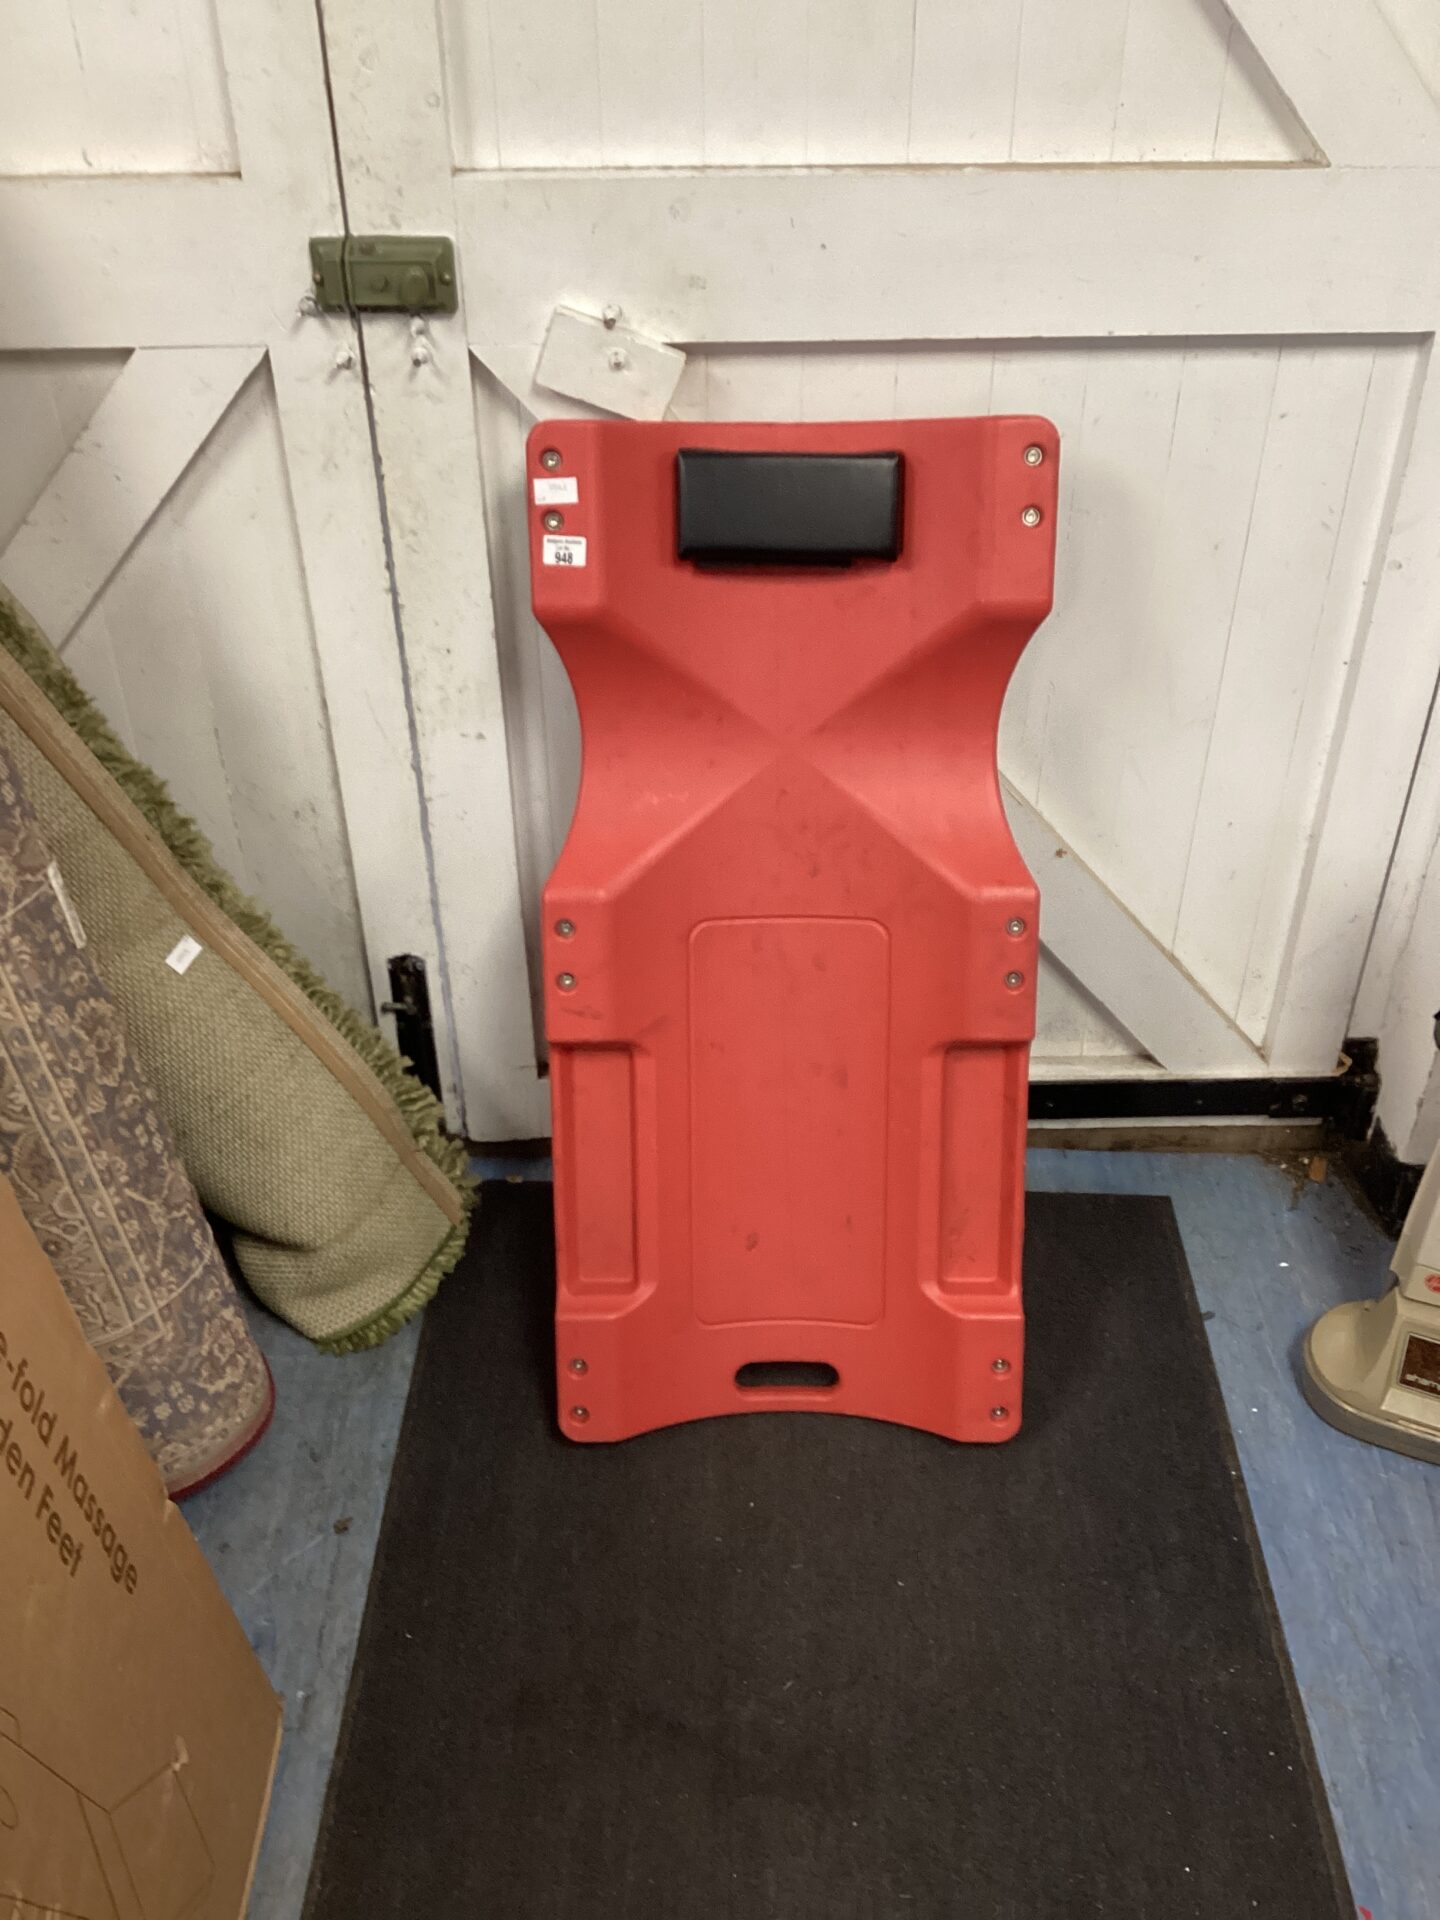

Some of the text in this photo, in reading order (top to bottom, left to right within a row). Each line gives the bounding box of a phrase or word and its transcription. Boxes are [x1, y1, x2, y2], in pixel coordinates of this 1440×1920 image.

[555, 552, 573, 565] 948
[36, 1484, 83, 1577] Feet
[53, 1434, 137, 1595] Massage
